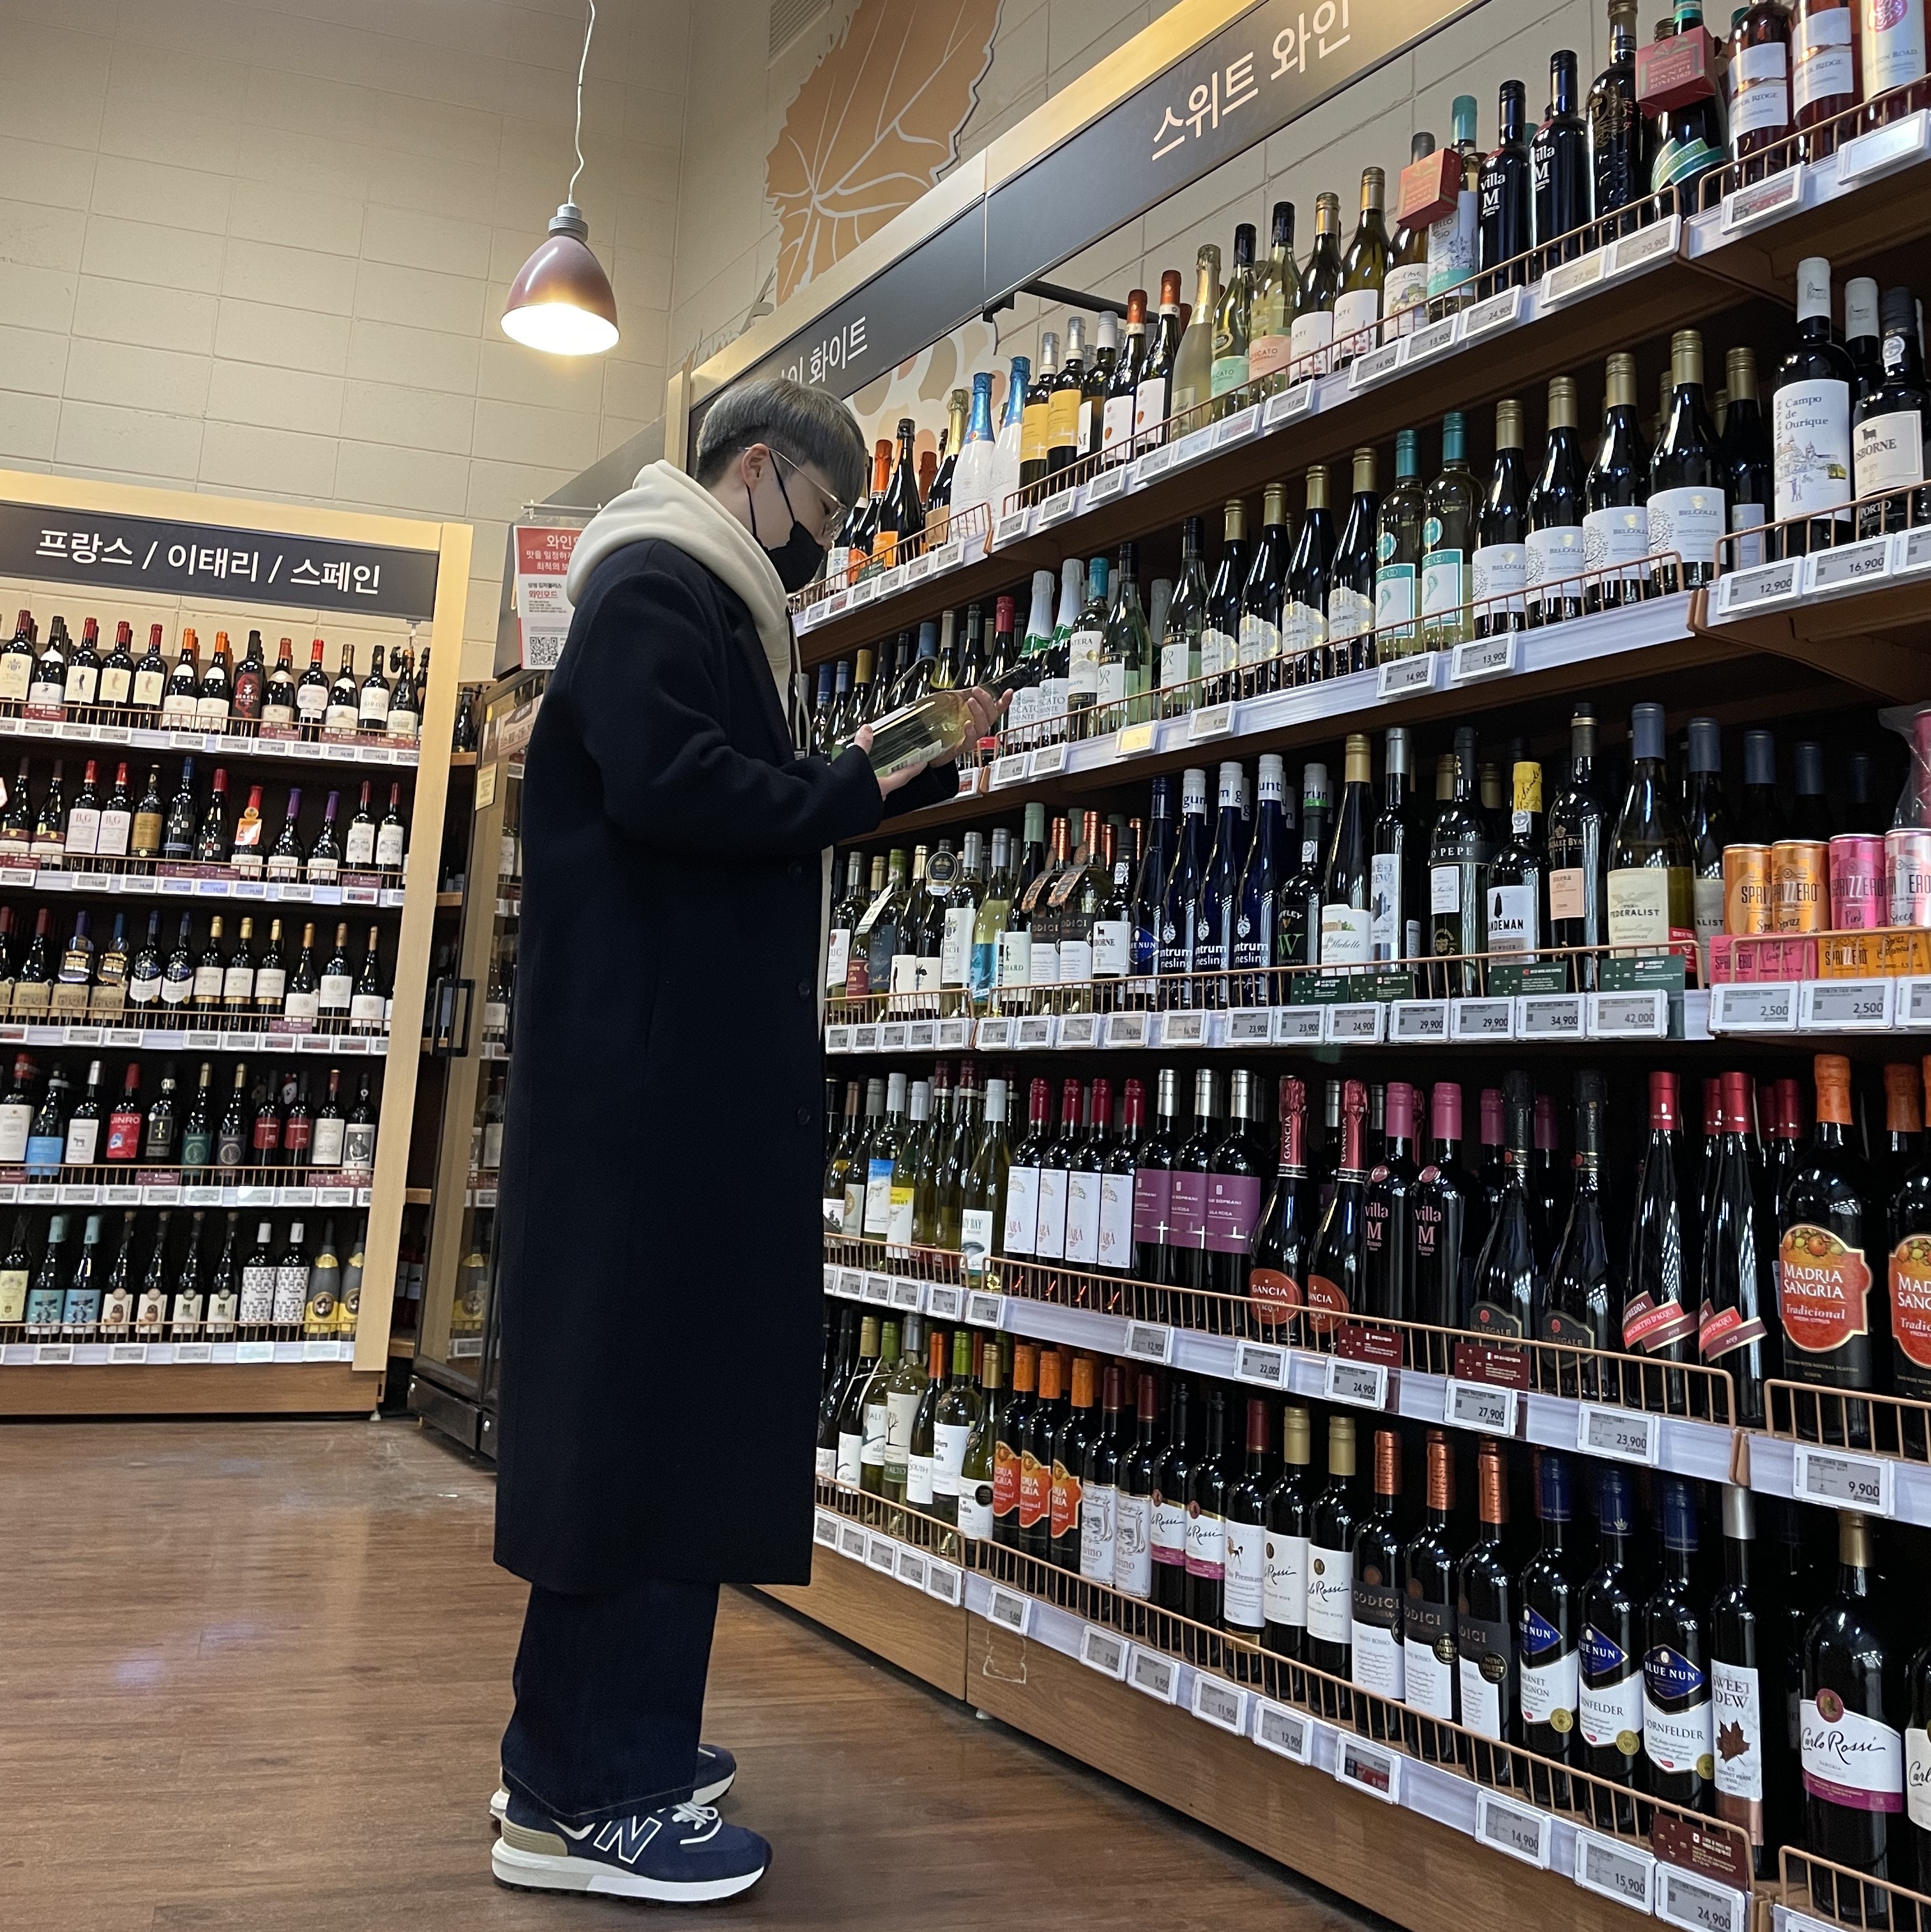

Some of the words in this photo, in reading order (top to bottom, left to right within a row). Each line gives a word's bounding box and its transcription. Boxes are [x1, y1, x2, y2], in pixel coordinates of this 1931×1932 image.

[1893, 49, 1918, 58] ROAD
[1816, 58, 1844, 71] RIDGE
[1151, 50, 1260, 162] 스위트
[1269, 0, 1351, 81] 와인
[1752, 92, 1778, 103] RIDGE
[1534, 162, 1550, 181] M
[1480, 172, 1506, 190] villa
[1482, 188, 1500, 208] M
[809, 316, 868, 384] 화이트
[1785, 396, 1822, 408] Campo
[1785, 409, 1797, 419] de
[1785, 417, 1829, 430] Ourique
[1860, 501, 1891, 517] PORTO
[526, 551, 541, 559] 맛을
[35, 529, 133, 567] 프랑스
[142, 541, 159, 570] /
[167, 545, 257, 582] 이태리
[266, 555, 284, 584] /
[290, 558, 380, 596] 스페인
[1849, 557, 1884, 574] 16,900
[1761, 579, 1792, 593] 12,900
[1483, 652, 1506, 664] 13,900
[1406, 670, 1427, 681] 14,900
[1440, 845, 1473, 856] PEPE
[1610, 908, 1660, 918] FEDERALIST
[1139, 941, 1155, 949] NUN
[1278, 934, 1303, 956] W
[1330, 938, 1361, 950] Michelle
[1761, 1005, 1789, 1017] 2,500
[1853, 1003, 1883, 1014] 2,500
[1420, 1019, 1443, 1030] 29,900
[1483, 1017, 1508, 1028] 29,900
[1550, 1015, 1578, 1027] 34,900
[1625, 1012, 1655, 1023] 42,000
[1248, 1024, 1268, 1033] 23,900
[1299, 1023, 1319, 1033] 23,900
[1352, 1021, 1375, 1031] 24,900
[110, 1116, 140, 1124] JINRO
[1284, 1116, 1292, 1159] GANCIA
[1365, 1203, 1388, 1219] villa
[1415, 1206, 1442, 1222] villa
[970, 1218, 983, 1229] BAY
[1367, 1221, 1382, 1240] M
[1418, 1226, 1435, 1245] M
[1783, 1261, 1844, 1284] MADRIA
[1252, 1284, 1287, 1297] GANCIA
[1783, 1279, 1845, 1300] SANGRIA
[1786, 1304, 1845, 1320] Tradicional
[1260, 1364, 1280, 1374] 22,000
[1353, 1383, 1376, 1395] 24,900
[1478, 1407, 1504, 1420] 27,900
[1616, 1434, 1647, 1448] 23,900
[1849, 1480, 1880, 1497] 9,900
[1234, 1571, 1263, 1583] Premium
[1268, 1564, 1296, 1585] Rossi
[1315, 1581, 1349, 1602] Rossi
[1353, 1590, 1399, 1609] CODICI
[1530, 1626, 1550, 1639] NUN
[1592, 1645, 1616, 1659] NUN
[1645, 1664, 1667, 1678] BLUE
[1670, 1667, 1696, 1682] NUN
[1713, 1673, 1750, 1695] SWEET
[1715, 1691, 1749, 1709] DEW
[1218, 1703, 1236, 1719] 11,900
[1282, 1731, 1301, 1747] 12,900
[1801, 1727, 1824, 1751] Carlo
[1826, 1731, 1885, 1765] Rossi
[593, 1816, 662, 1864] N
[1511, 1830, 1538, 1850] 14,900
[1615, 1873, 1645, 1894] 15,900
[1697, 1906, 1730, 1929] 24,900
